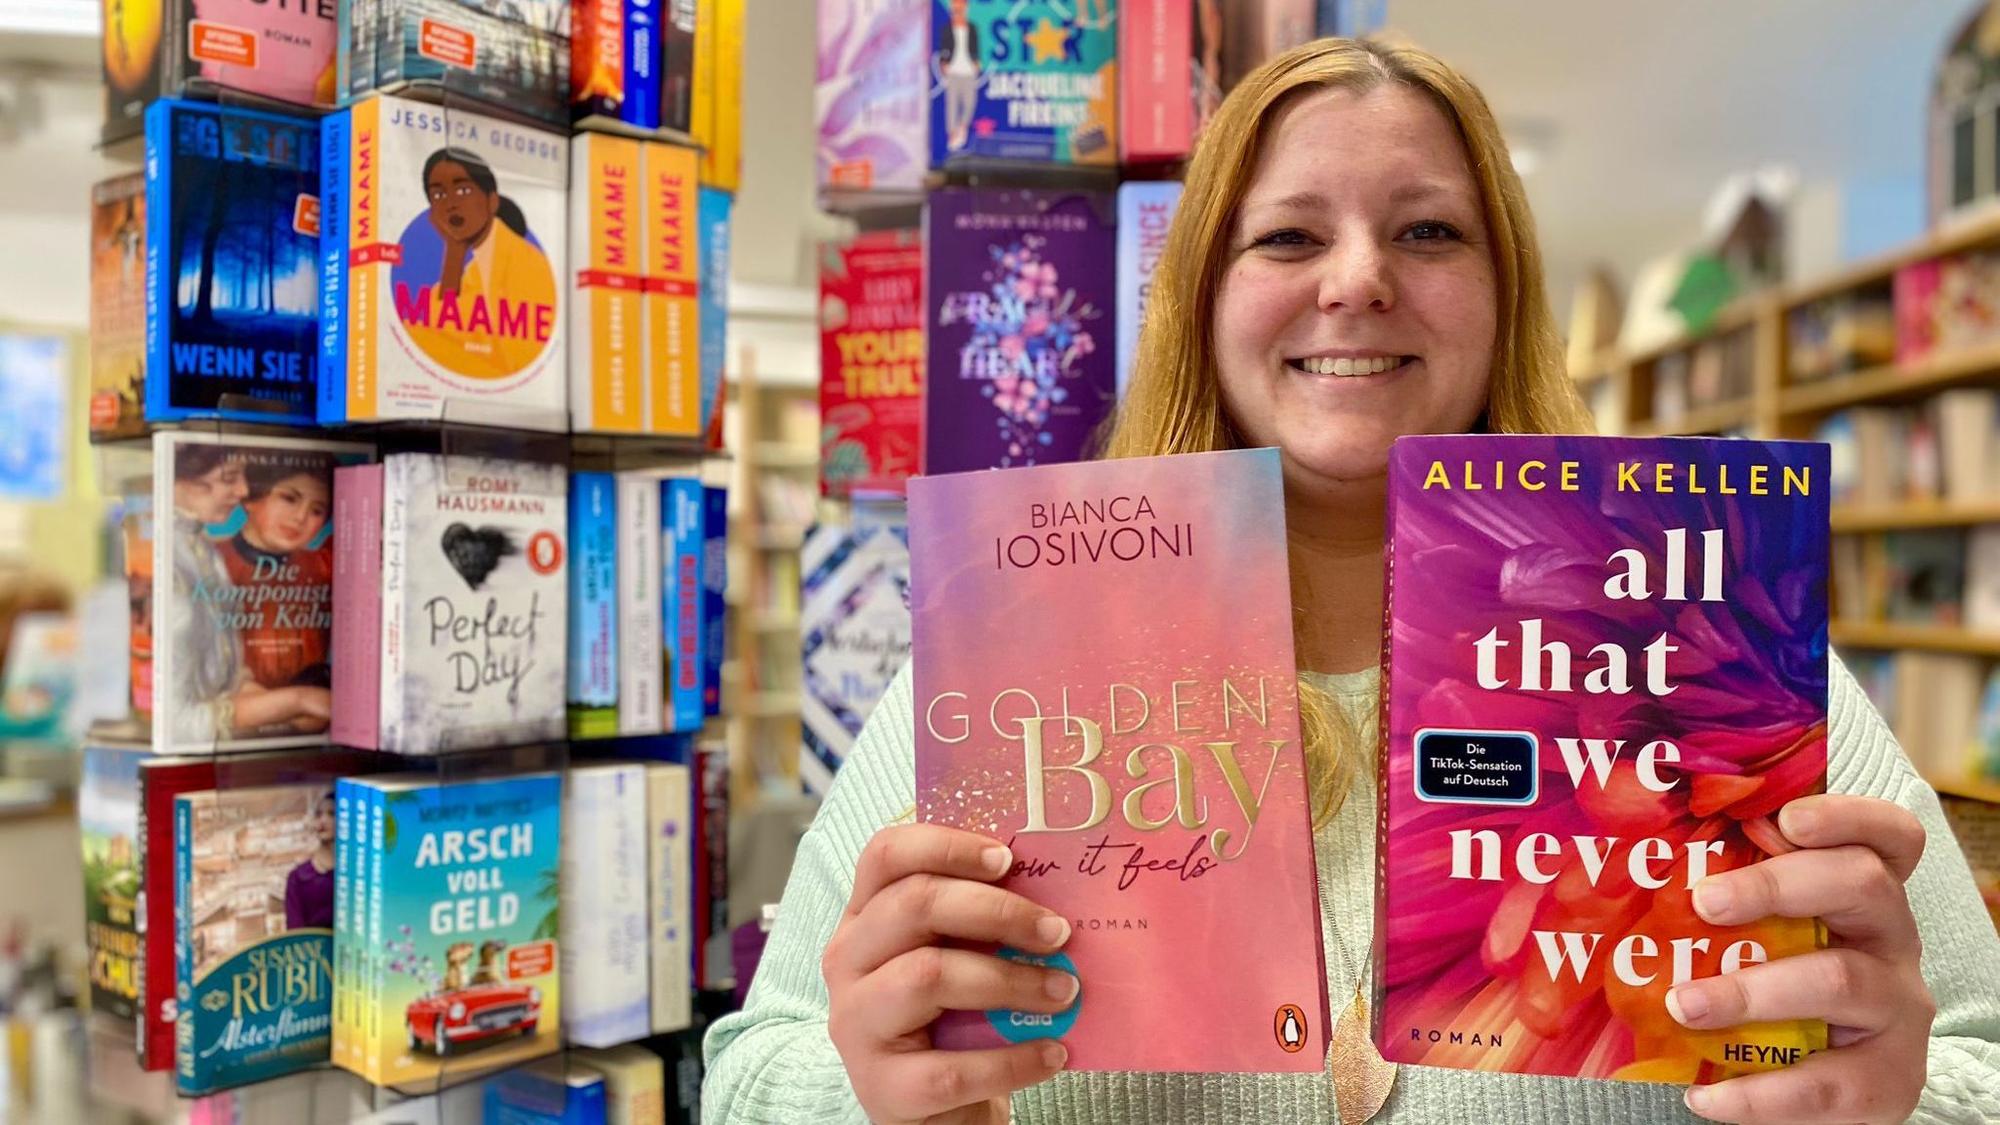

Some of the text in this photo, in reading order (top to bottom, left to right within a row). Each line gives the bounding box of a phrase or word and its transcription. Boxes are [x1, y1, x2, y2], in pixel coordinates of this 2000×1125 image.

[991, 19, 1084, 64] STR
[391, 108, 559, 161] JESSICA GEORGE
[357, 128, 372, 240] MAAME
[604, 164, 627, 266] MAAME
[661, 173, 682, 272] MAAME
[396, 281, 553, 343] MAAME
[172, 343, 255, 378] WENN
[262, 350, 301, 382] SIE
[840, 363, 922, 399] TRUL
[466, 476, 523, 494] ROMY
[1423, 461, 1810, 496] ALICE KELLEN
[436, 496, 546, 515] HAUSMANN
[1031, 495, 1156, 528] BIANCA
[995, 523, 1193, 569] IOSIVONI
[1603, 528, 1726, 602] all
[252, 556, 301, 582] Die
[216, 604, 332, 631] von Köln
[424, 590, 546, 652] Perfect
[447, 651, 536, 706] Day
[1473, 618, 1679, 696] that
[926, 676, 1270, 744] GOLDEN
[1430, 758, 1522, 772] TikTok-Sensation
[1466, 743, 1486, 756] Die
[1554, 737, 1681, 792] we
[1011, 715, 1291, 861] Bay
[1443, 774, 1509, 788] auf Deutsch
[414, 822, 534, 868] ARSCH
[1006, 835, 1218, 890] ow it feels
[1449, 828, 1725, 890] never
[447, 868, 504, 894] VOLL
[429, 892, 520, 936] GELD
[1076, 919, 1149, 931] ROMAN
[1532, 930, 1769, 988] were
[1411, 1028, 1502, 1048] ROMAN
[1724, 1043, 1801, 1065] HEYNE
